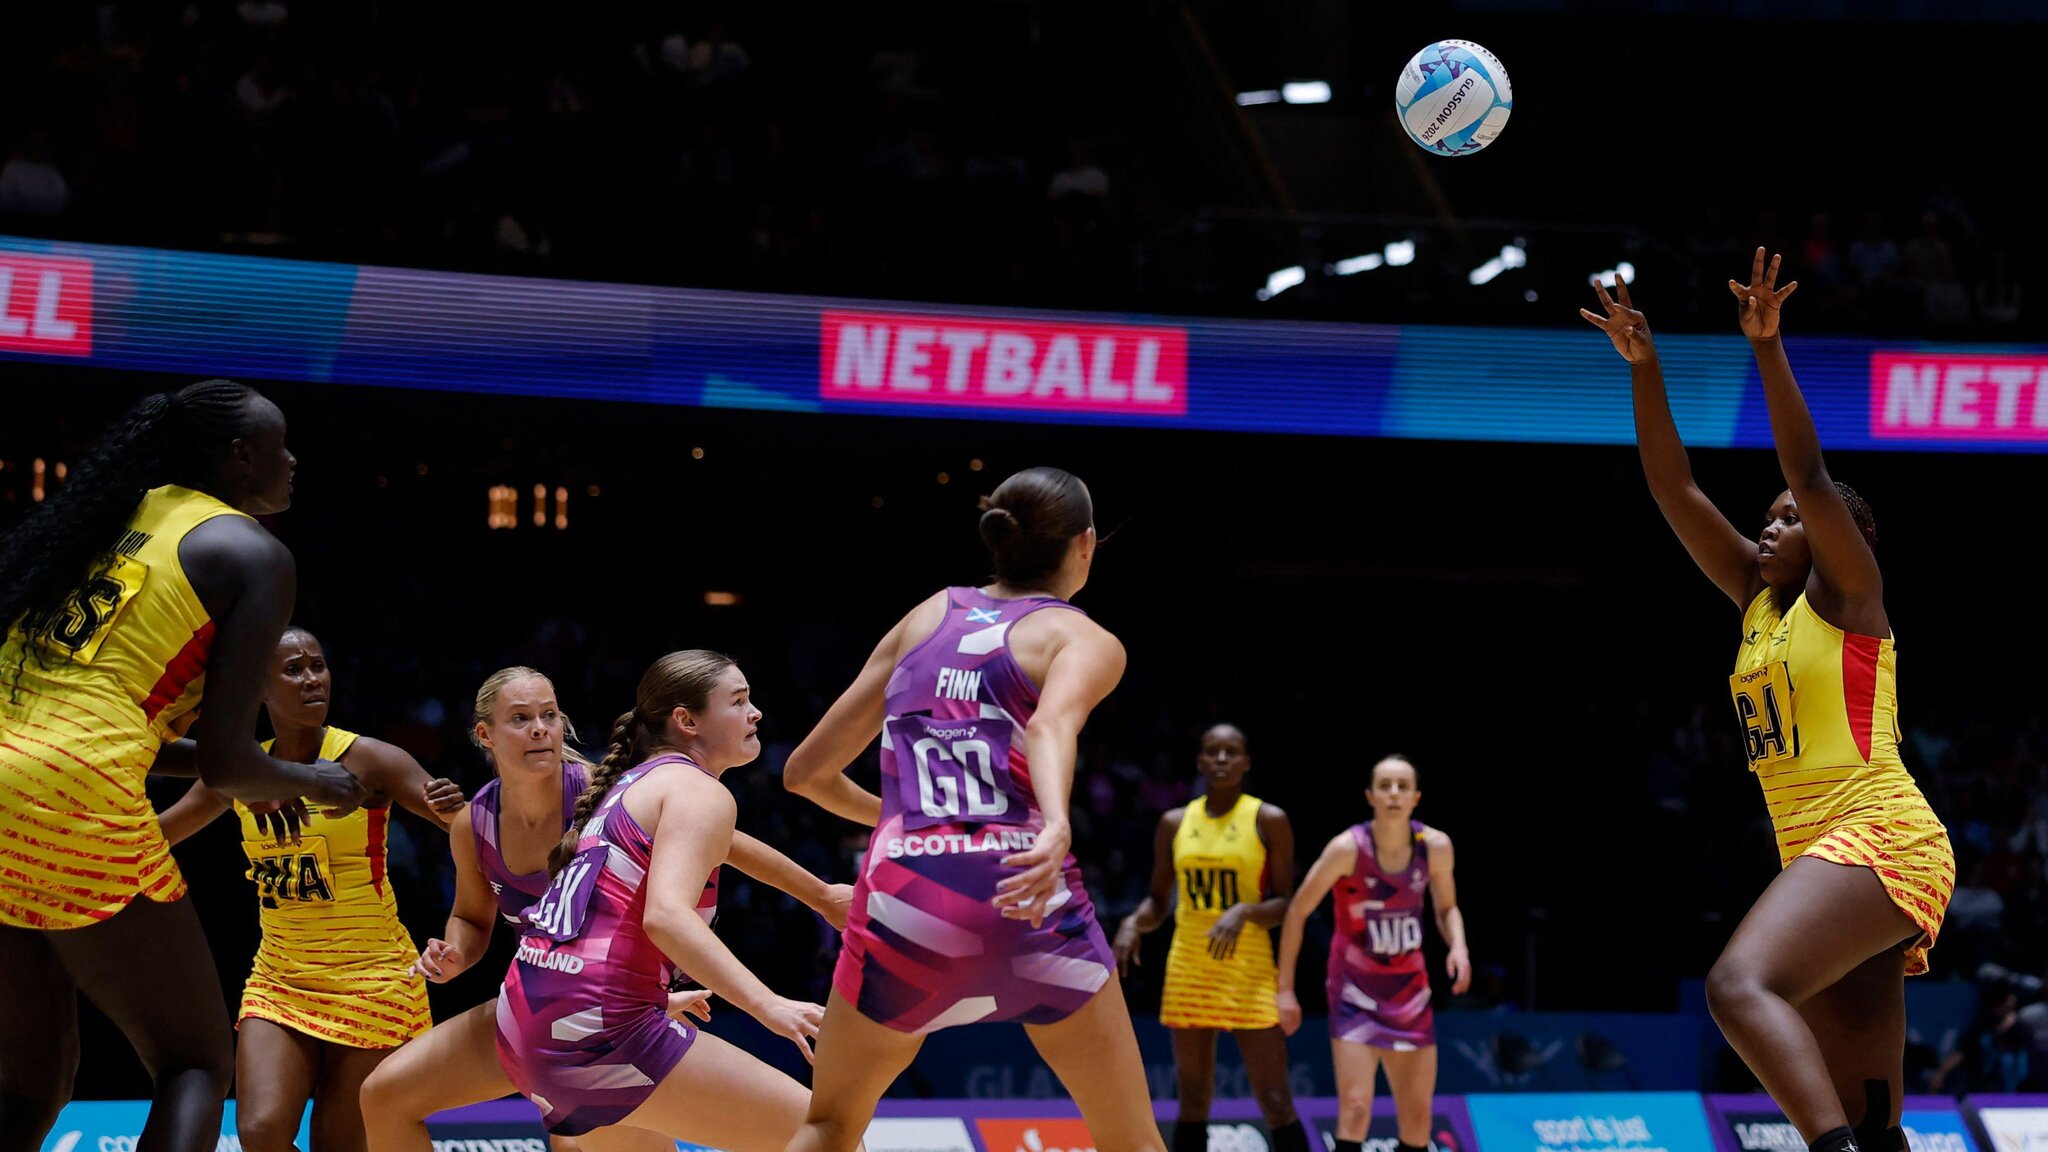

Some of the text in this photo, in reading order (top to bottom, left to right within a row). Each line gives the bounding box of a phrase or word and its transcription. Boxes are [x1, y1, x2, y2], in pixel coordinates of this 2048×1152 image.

[1436, 78, 1474, 125] GLASGOW
[1421, 122, 1440, 141] 2026
[833, 323, 1174, 403] NETBALL
[935, 667, 982, 702] FINN
[1741, 670, 1763, 683] agen
[1736, 682, 1787, 767] GA
[913, 738, 1008, 818] GD
[887, 831, 1037, 859] SCOTLAND
[1184, 867, 1240, 911] WD
[1368, 916, 1423, 955] WD
